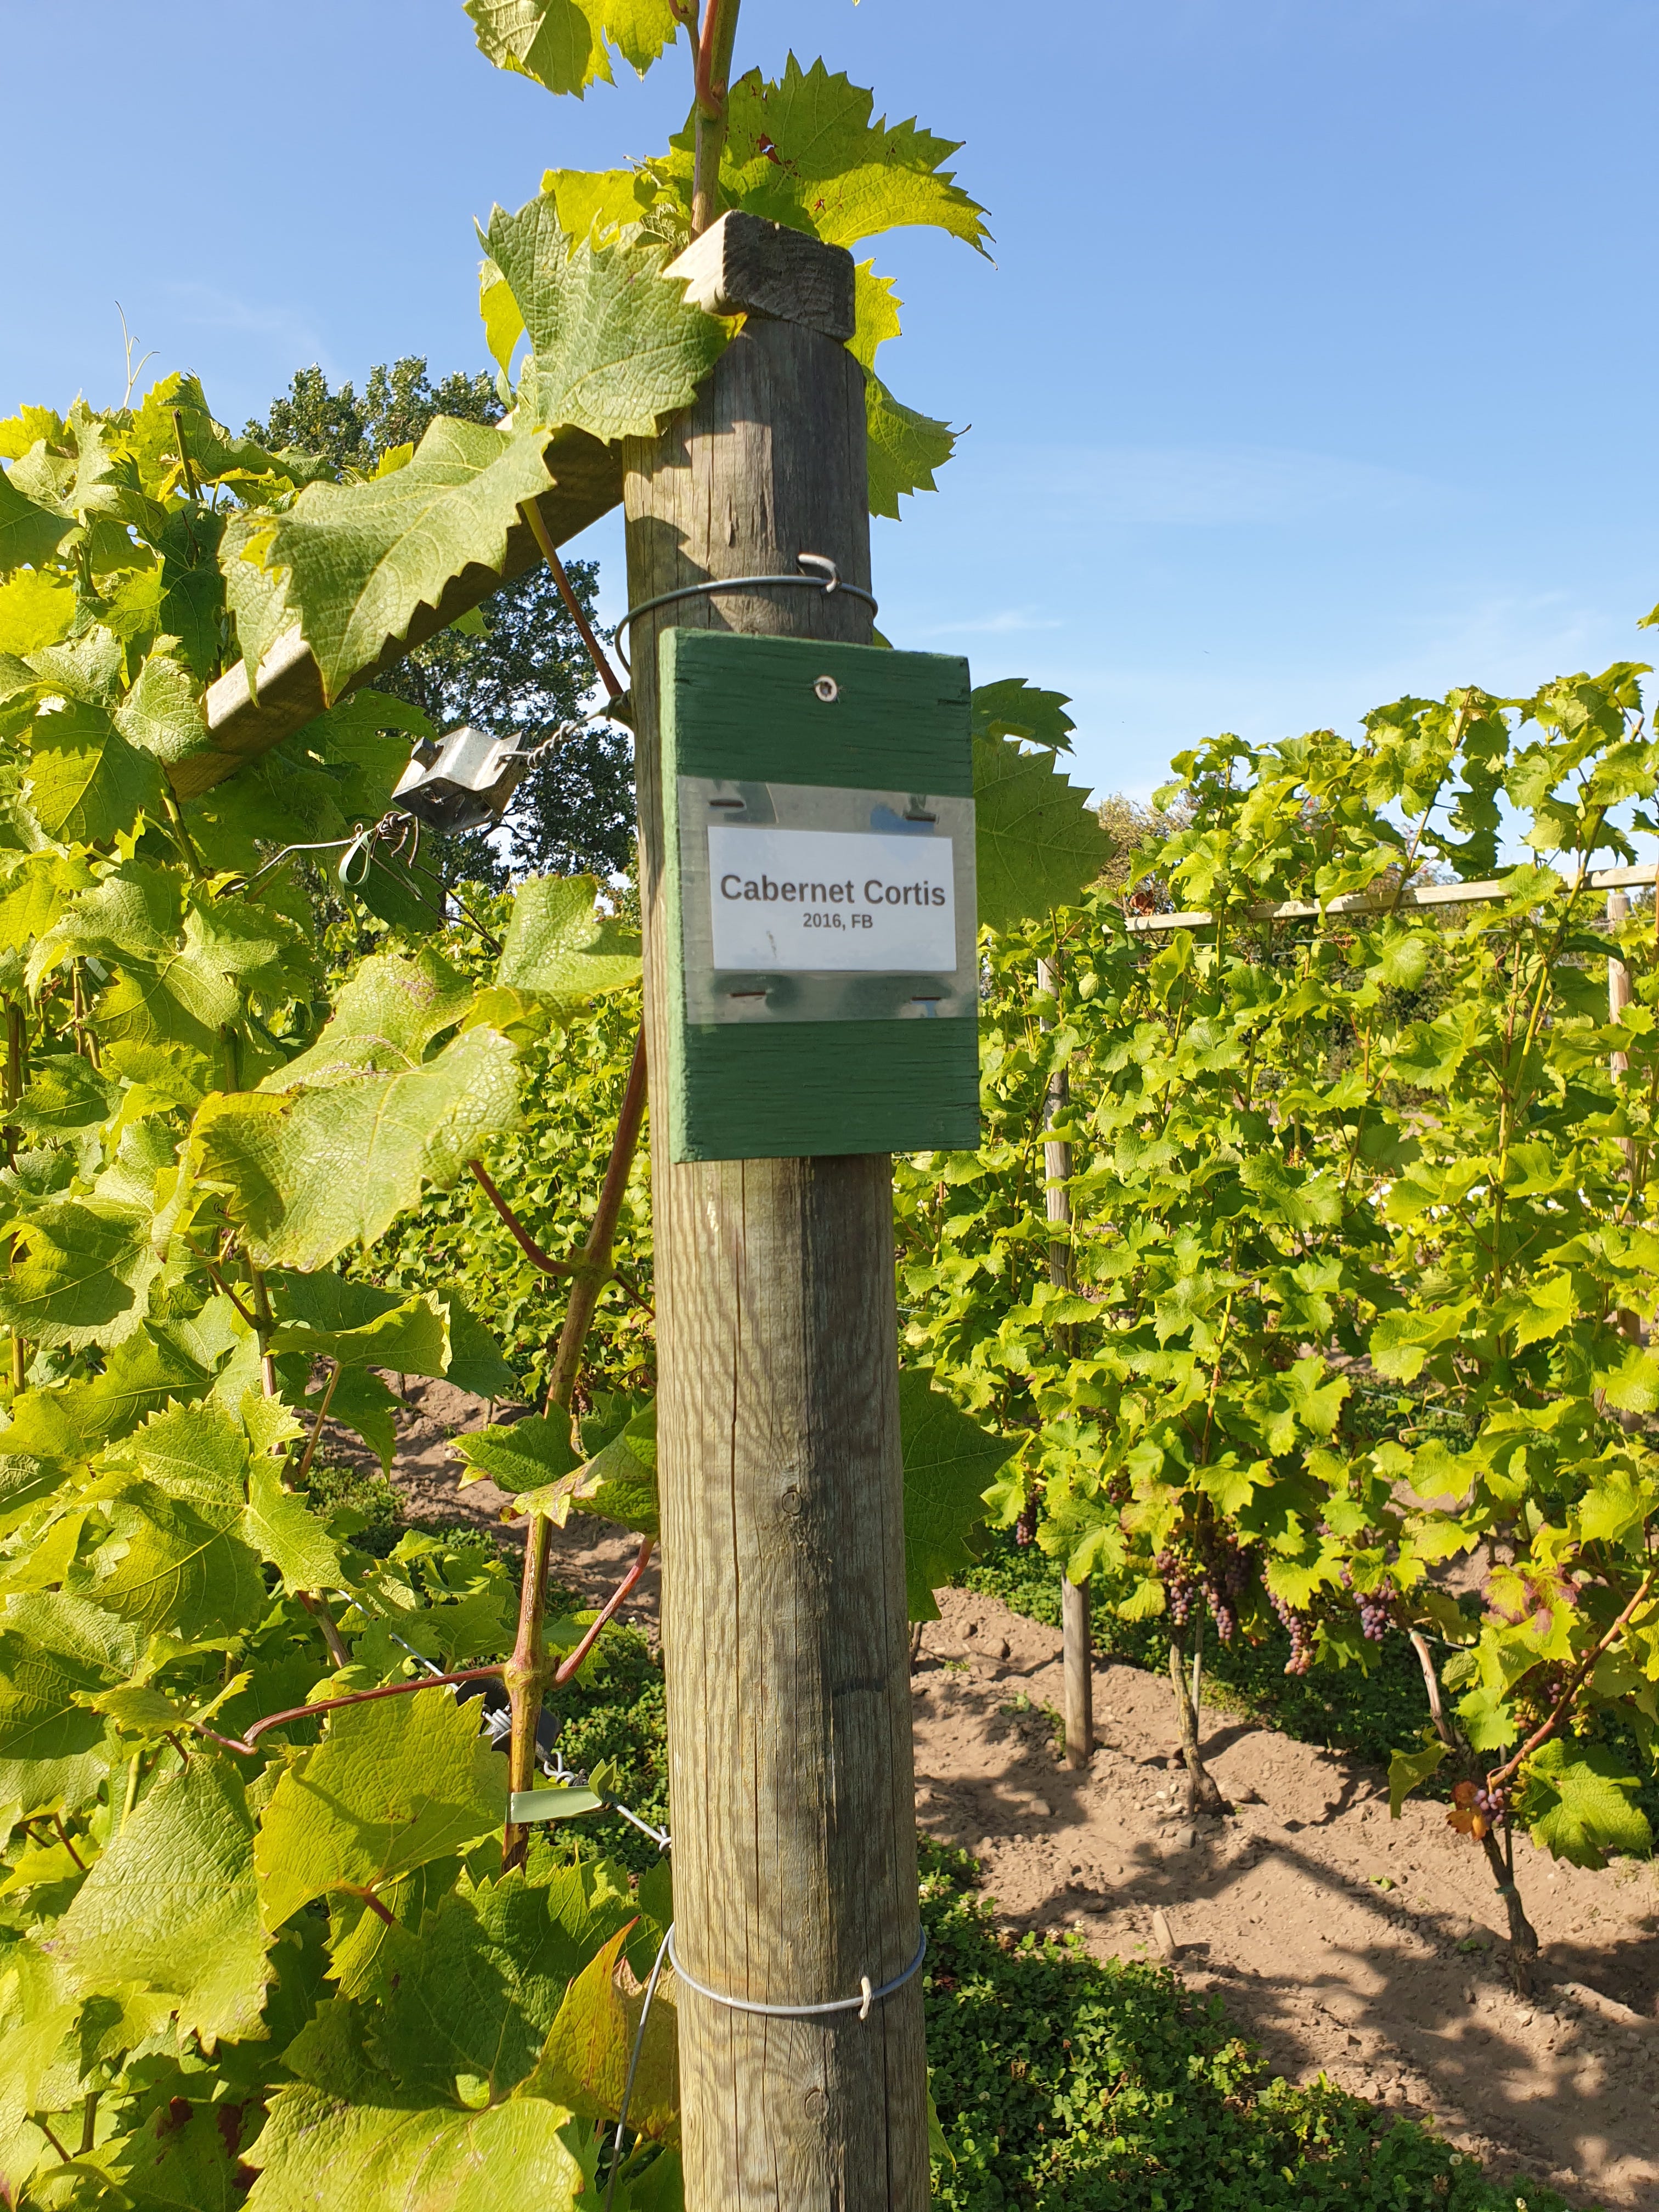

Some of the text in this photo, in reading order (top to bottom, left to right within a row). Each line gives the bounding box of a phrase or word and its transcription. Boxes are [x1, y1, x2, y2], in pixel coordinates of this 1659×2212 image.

[720, 873, 946, 906] Cabernet Cortis
[803, 912, 873, 931] 2016, FB
